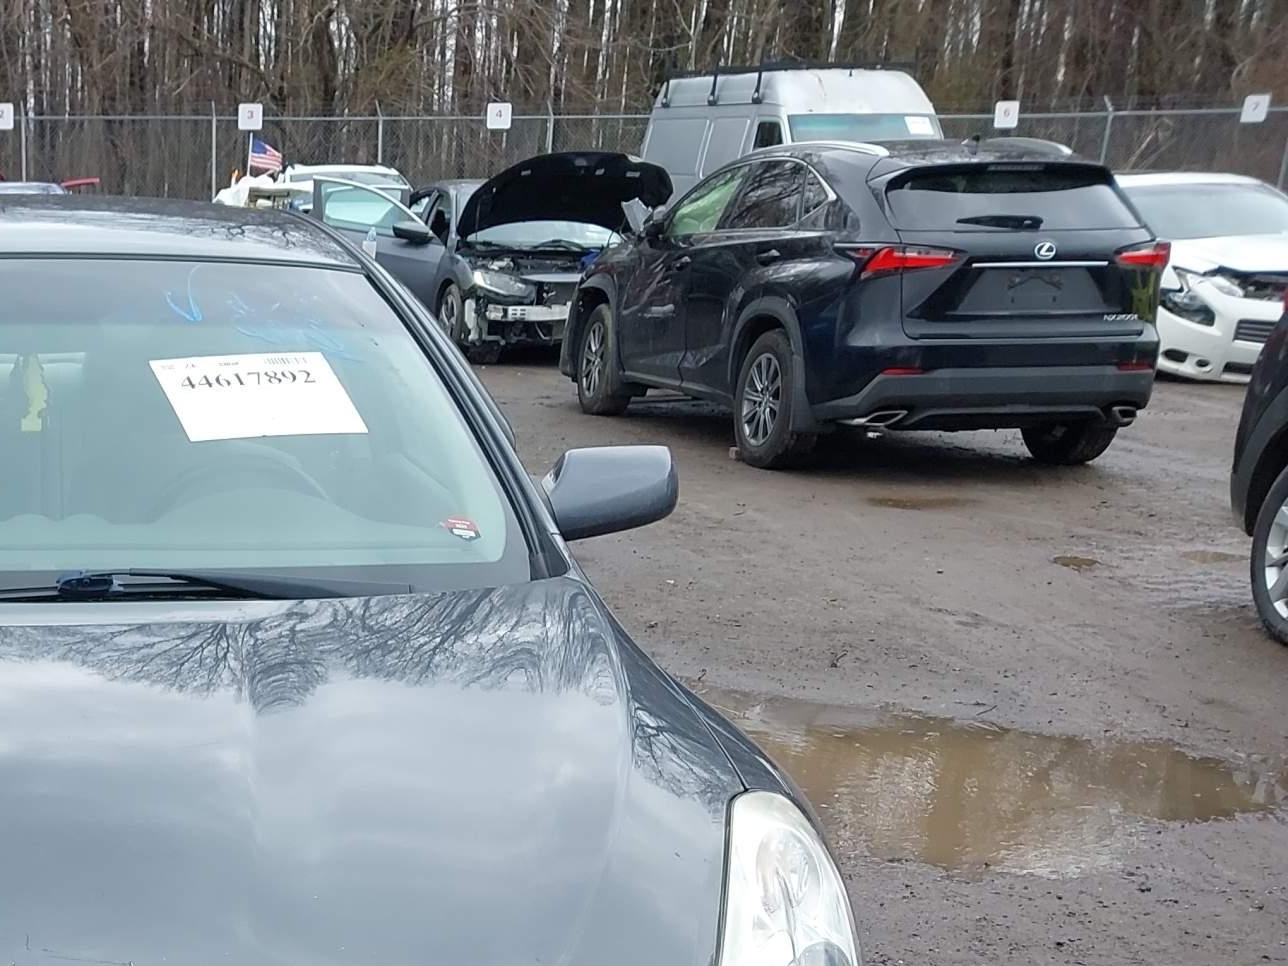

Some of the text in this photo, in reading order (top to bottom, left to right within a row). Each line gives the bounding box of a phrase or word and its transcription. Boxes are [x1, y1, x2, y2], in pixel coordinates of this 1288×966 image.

[247, 110, 255, 119] 3
[495, 109, 503, 119] 4
[181, 370, 316, 389] 44617892
